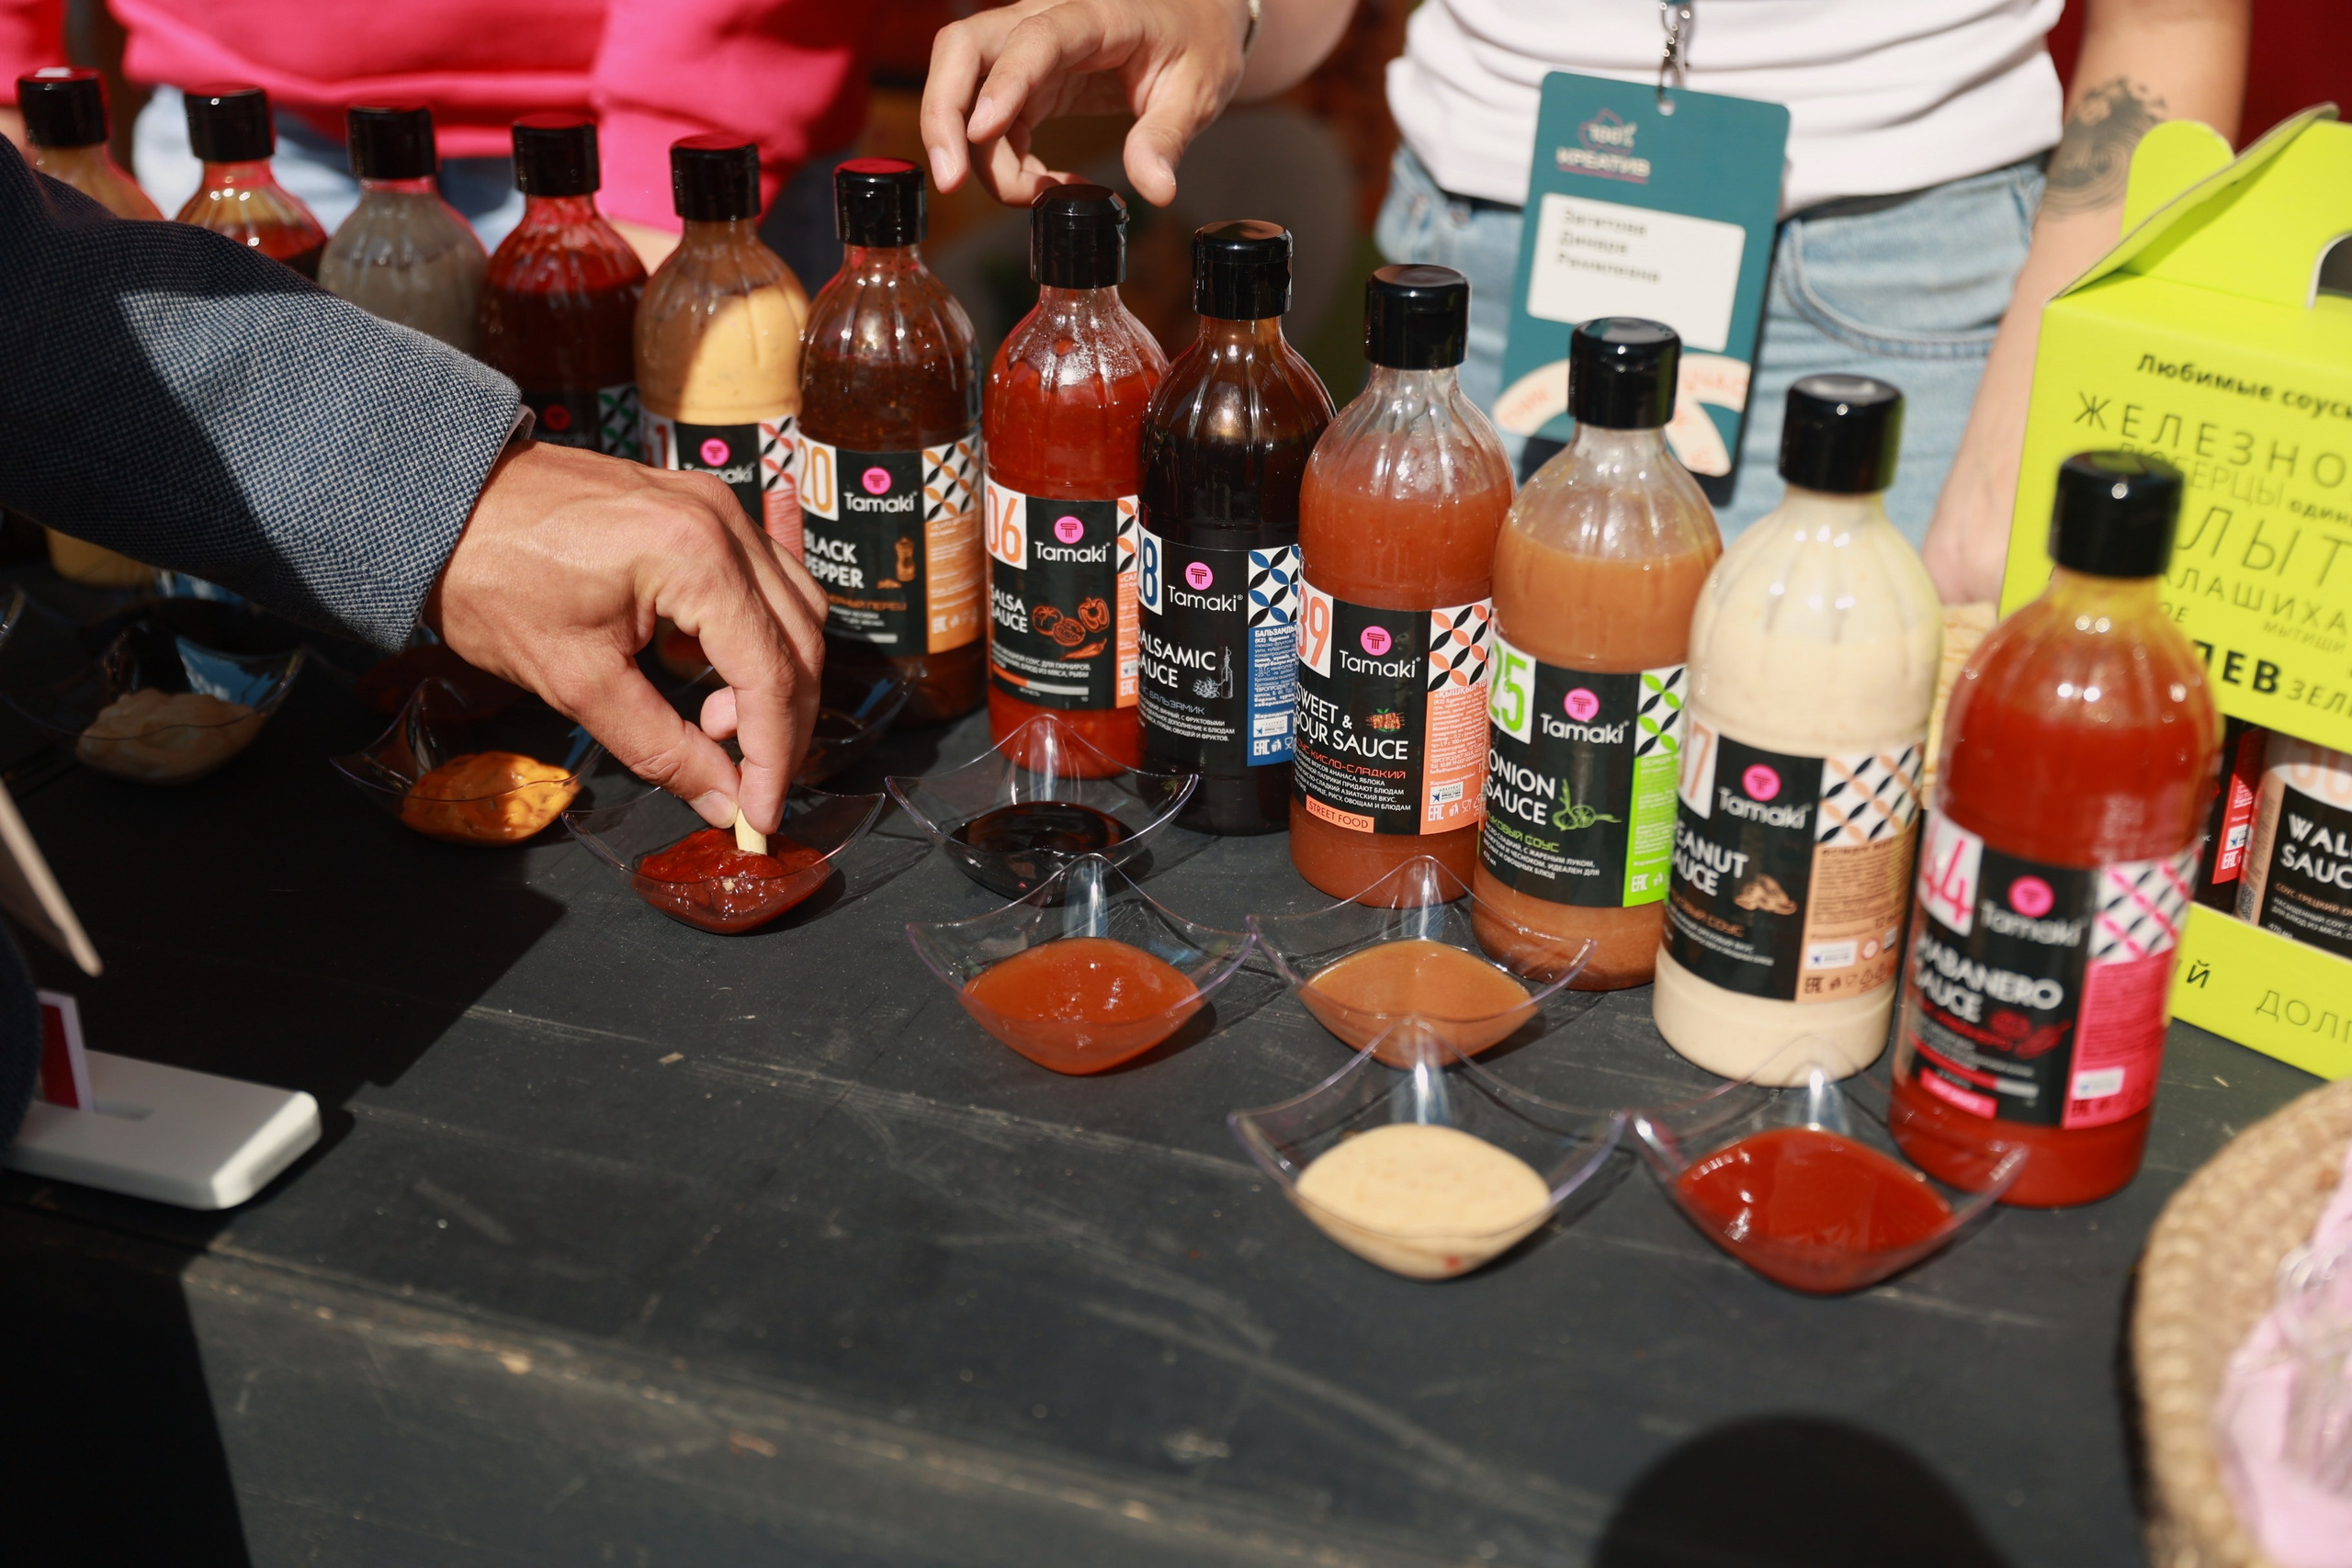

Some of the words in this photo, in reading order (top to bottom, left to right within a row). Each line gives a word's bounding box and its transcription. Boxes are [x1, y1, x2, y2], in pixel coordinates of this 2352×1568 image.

[1589, 122, 1637, 148] 100%
[1555, 147, 1651, 177] КРЕАТИВ
[2138, 353, 2273, 401] Любимые
[2074, 391, 2350, 491] ЖЕЛЕЗНО
[683, 462, 755, 485] maki
[798, 437, 833, 513] 20
[843, 492, 915, 513] Tamaki
[2290, 499, 2352, 529] один
[987, 484, 1022, 563] 06
[805, 528, 858, 565] BLACK
[1035, 541, 1107, 563] Tamaki
[806, 554, 865, 589] PEPPER
[1138, 535, 1159, 607] 8
[990, 584, 1026, 615] SALSA
[1168, 585, 1237, 612] Tamaki
[2164, 567, 2349, 636] ЛАШИХА
[991, 601, 1028, 634] SAUCE
[1298, 583, 1329, 669] 39
[2263, 619, 2346, 654] МЫТИЩИ
[1339, 649, 1416, 679] Tamaki
[2192, 639, 2281, 695] ЛЕВ
[2286, 679, 2352, 717] ЗЕЛ
[1488, 639, 1526, 732] 25
[1149, 689, 1206, 716] БАЛЬЗАМИК
[1296, 682, 1339, 725] SWEET
[1341, 715, 1353, 731] &
[1168, 717, 1203, 732] ДОПОЛНЕНИЕ
[1208, 727, 1236, 735] БЛЮДАМ
[1172, 728, 1196, 739] ОВОЩЕЙ
[1202, 733, 1229, 742] ФРУКТОВ.
[1185, 716, 1226, 727] ФРУКТОВЫМИ
[1296, 705, 1329, 746] SOUR
[1332, 729, 1408, 761] SAUCE
[1540, 714, 1626, 745] Tamaki
[1253, 739, 1270, 756] EAC
[1311, 750, 1407, 780] КИСЛО-СЛАДКИЙ
[1329, 769, 1358, 783] АНАНАСА,
[1359, 778, 1385, 787] ЯБЛОКА
[1488, 749, 1555, 800] ONION
[1317, 770, 1341, 786] ПАПРИКИ
[1342, 781, 1373, 794] ПРИДАЮТ
[1374, 788, 1405, 796] БЛЮДАМ
[1341, 788, 1378, 801] АЗИАТСКИЙ
[1379, 795, 1397, 804] ВКУС.
[1308, 800, 1336, 821] STREET
[1338, 815, 1369, 829] FOOD
[1329, 792, 1343, 803] РИСУ,
[1344, 797, 1373, 809] ОВОЩАМ
[1381, 803, 1411, 811] БЛЮДАМ
[1428, 805, 1444, 822] EAC
[1487, 775, 1548, 826] SAUCE
[1718, 786, 1805, 830] Tamaki
[1525, 832, 1560, 854] СОУС
[1676, 819, 1750, 879] EANUT
[2288, 812, 2352, 860] WAL
[1529, 849, 1566, 864] ЖАРЕНЫМ
[1566, 857, 1595, 868] ЛУКОМ,
[1548, 863, 1584, 875] ИДЕАЛЕН
[1584, 868, 1600, 876] ДЛЯ
[1673, 848, 1720, 897] AUCE
[2221, 851, 2239, 871] EAC
[2280, 842, 2352, 892] SAUC
[1534, 869, 1555, 881] БЛЮД
[1631, 874, 1649, 893] EAC
[2274, 897, 2324, 924] НАСЫЩЕННЫЙ
[2325, 918, 2347, 931] СОУС
[2276, 883, 2297, 898] СОУС
[2298, 891, 2340, 914] ГРЕЦКИЙ
[1980, 899, 2080, 948] Tamaki
[2285, 910, 2306, 927] БЛЮД
[2307, 919, 2318, 930] ИЗ
[2319, 923, 2345, 941] МЯСА,
[1914, 930, 2064, 1010] HABANERO
[1914, 956, 1984, 1024] SAUCE
